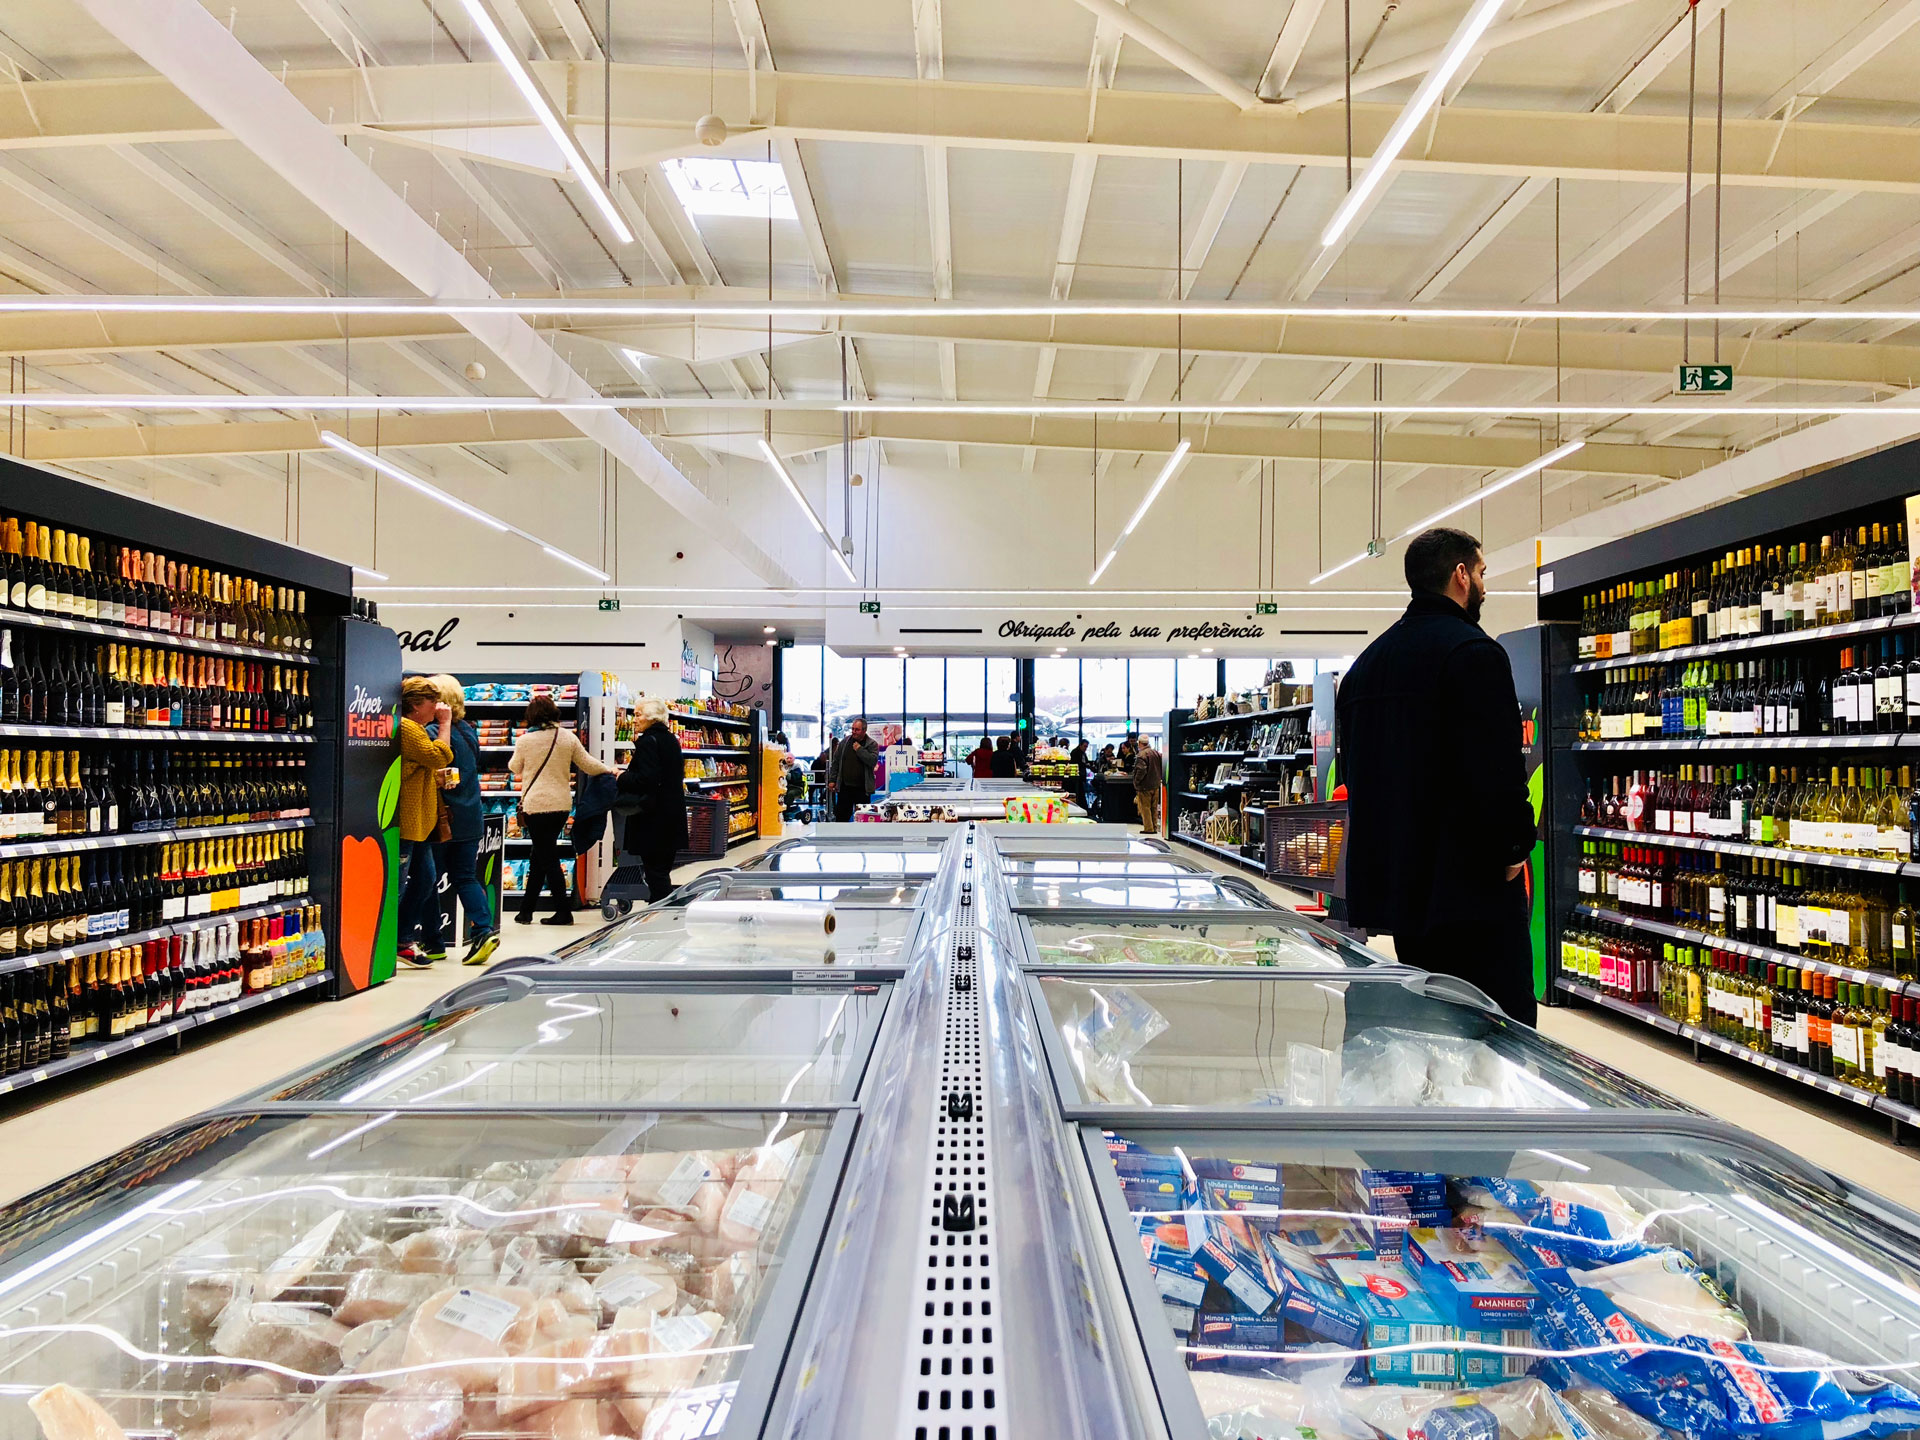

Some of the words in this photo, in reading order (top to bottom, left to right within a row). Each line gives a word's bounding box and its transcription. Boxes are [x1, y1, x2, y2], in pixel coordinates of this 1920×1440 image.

[998, 619, 1076, 642] Obrigado
[1081, 621, 1122, 642] pela
[1129, 624, 1161, 638] sua
[1166, 620, 1265, 642] preferência
[348, 684, 383, 719] Hiper
[347, 739, 391, 747] SUPERMERCADOS
[1233, 1182, 1259, 1191] Pescada
[1264, 1184, 1281, 1192] Cabo
[1373, 1185, 1413, 1195] PESCANOVA
[1290, 1290, 1310, 1304] Mimos
[1316, 1301, 1339, 1316] Pescada
[1345, 1314, 1361, 1326] Cabo
[1478, 1299, 1530, 1308] AMANHECE
[1230, 1314, 1255, 1322] Pescada
[1223, 1343, 1248, 1351] Pescada
